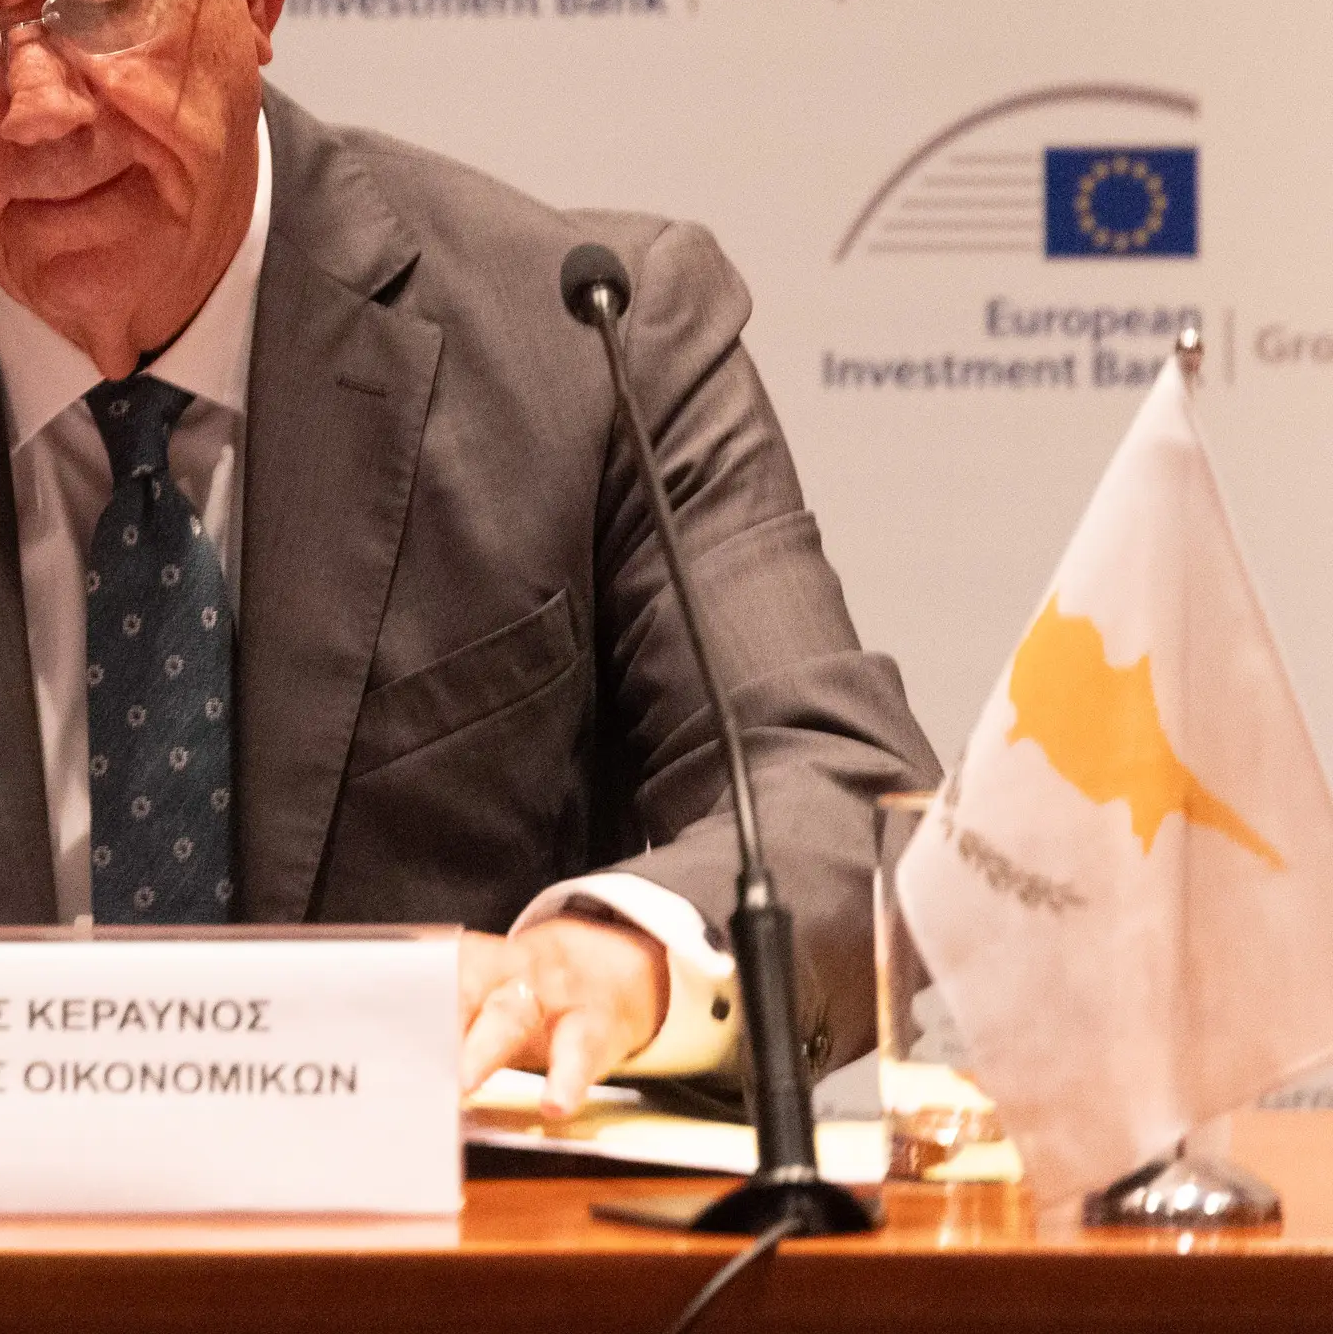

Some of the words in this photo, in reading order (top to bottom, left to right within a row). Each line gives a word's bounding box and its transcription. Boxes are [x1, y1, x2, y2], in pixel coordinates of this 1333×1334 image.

[984, 296, 1205, 348] European
[821, 351, 1077, 389] Investment
[27, 999, 268, 1032] ΚΕΡΑΥΝΟΣ
[22, 1060, 358, 1095] ΟΙΚΟΝΟΜΙΚΩΝ
